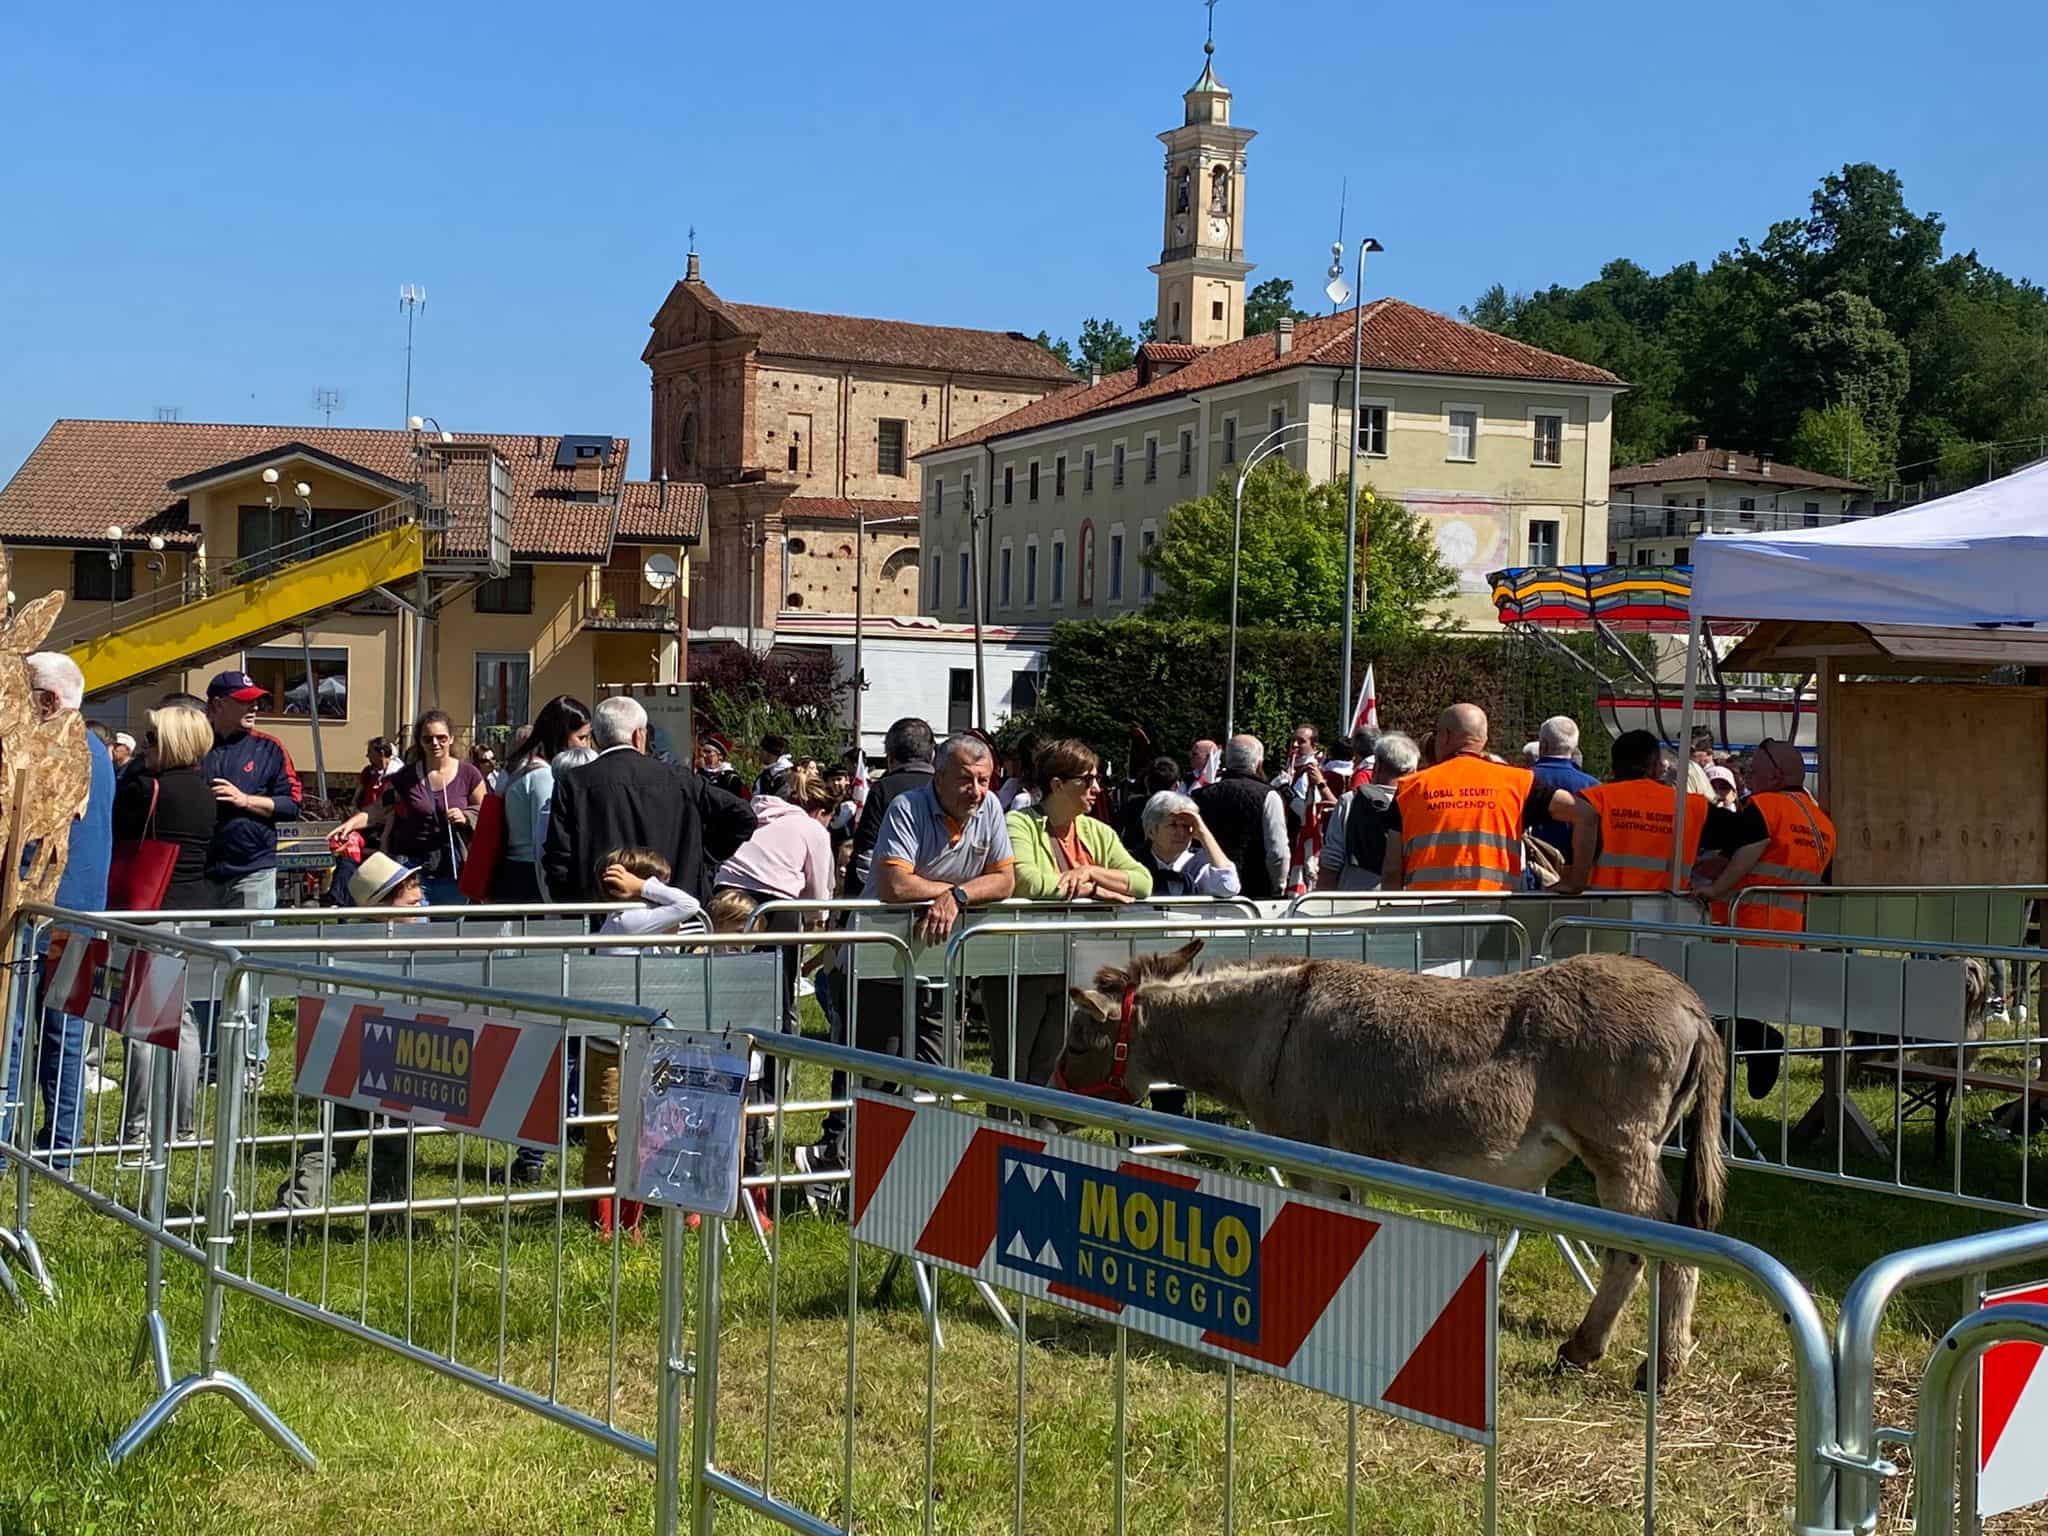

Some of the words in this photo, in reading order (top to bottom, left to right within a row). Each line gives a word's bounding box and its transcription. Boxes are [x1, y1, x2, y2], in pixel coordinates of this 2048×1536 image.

[1423, 788, 1455, 800] GLOBAL
[1426, 800, 1497, 811] ANTINCENDO
[396, 1029, 469, 1076] MOLLO
[393, 1073, 467, 1106] NOLEGGIO
[1079, 1179, 1252, 1277] MOLLO
[1078, 1250, 1251, 1326] NOLEGGIO
